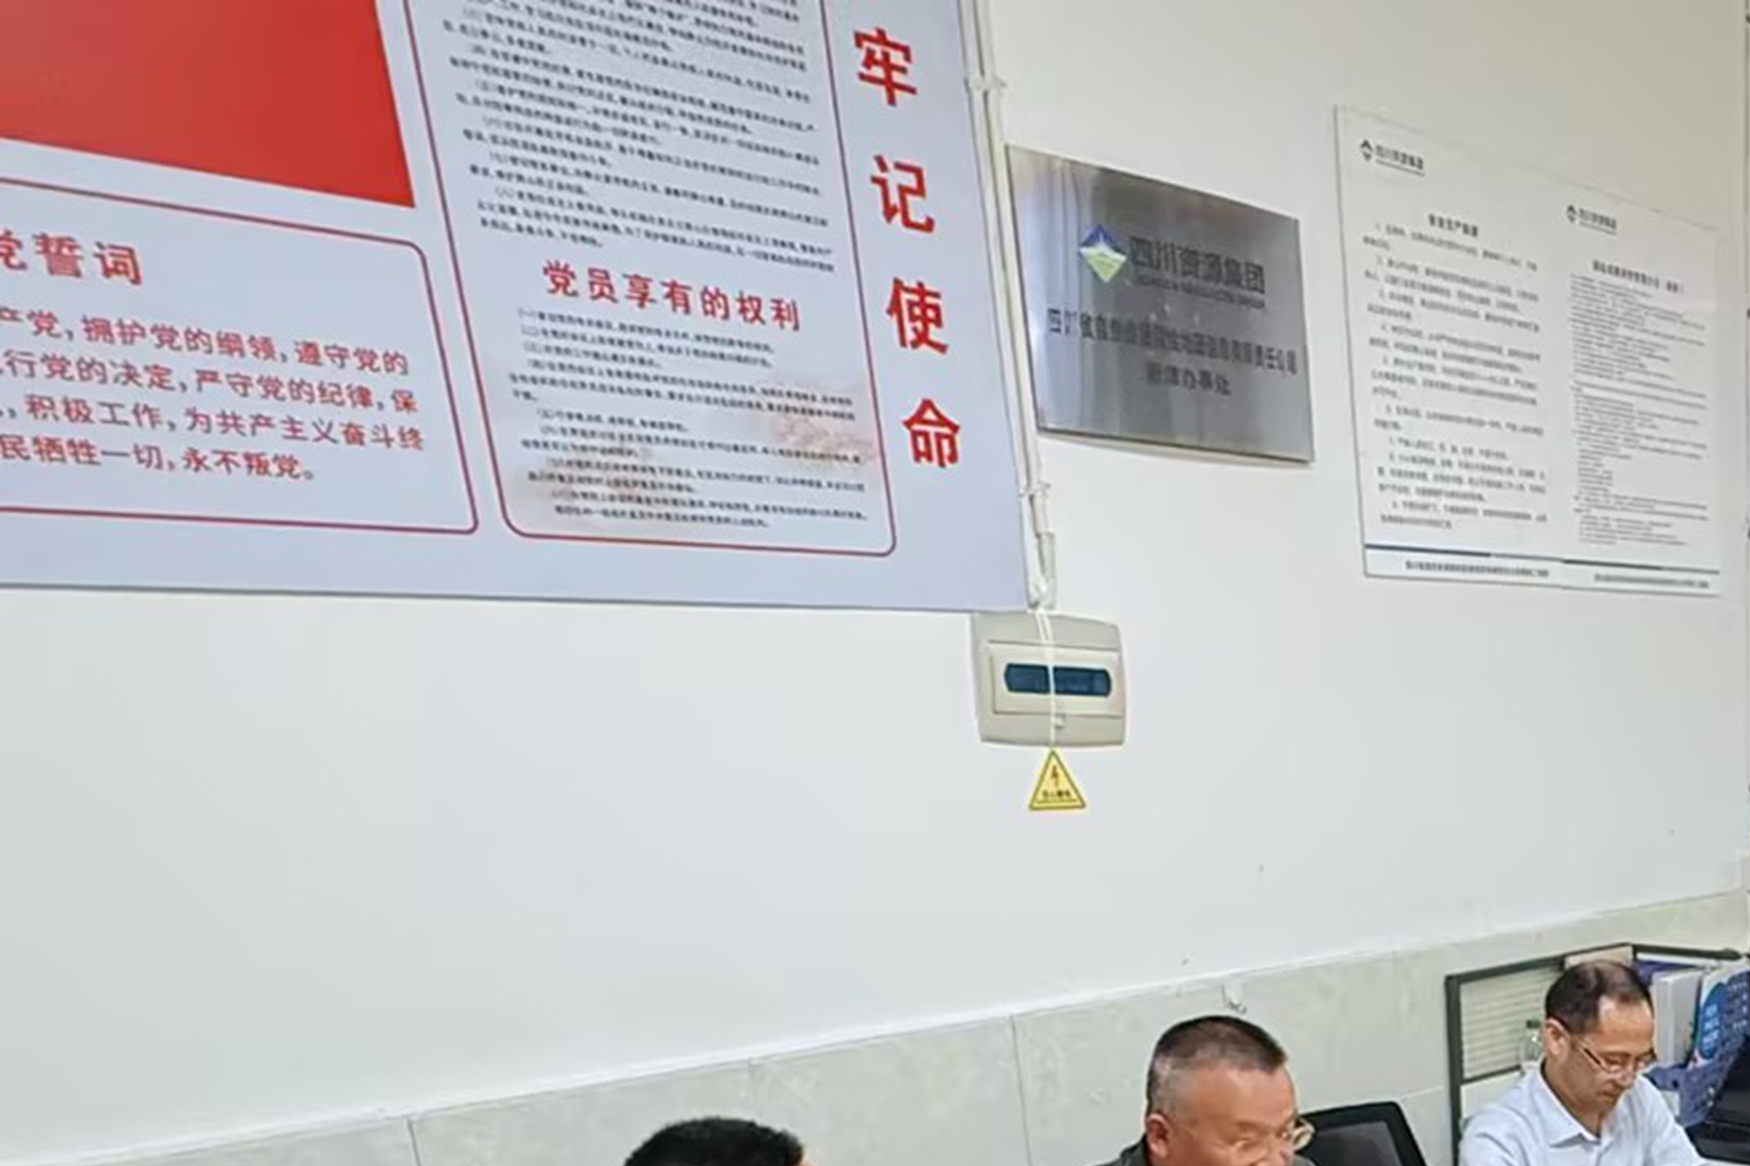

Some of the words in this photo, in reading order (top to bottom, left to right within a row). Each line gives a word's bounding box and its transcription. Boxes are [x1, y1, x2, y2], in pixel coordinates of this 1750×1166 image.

[854, 27, 960, 468] 牢记使命
[542, 260, 800, 331] 党员享有的权利
[0, 350, 418, 413] 行党的决定，严守党的纪律，保
[0, 394, 424, 450] ，积极工作，为共产主义奋斗终
